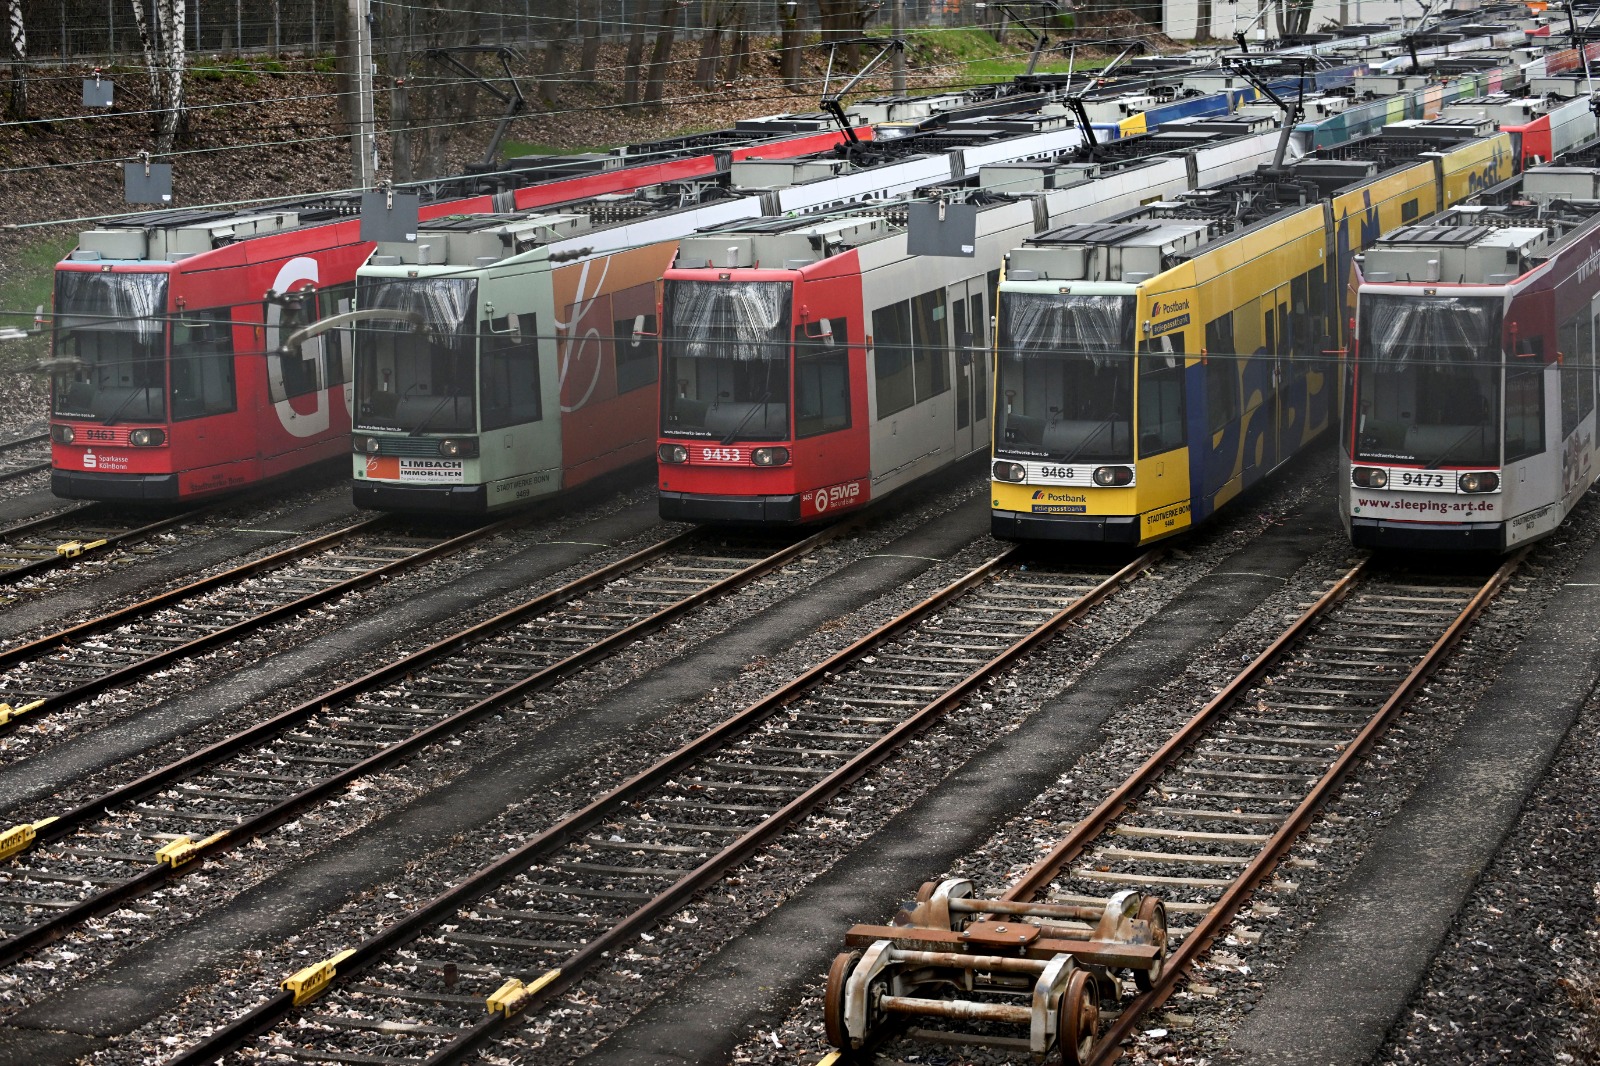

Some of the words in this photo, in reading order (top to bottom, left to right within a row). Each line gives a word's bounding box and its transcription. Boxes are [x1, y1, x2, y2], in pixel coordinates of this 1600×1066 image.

[1163, 298, 1190, 314] Postbank
[86, 429, 115, 441] 9463
[98, 455, 129, 463] Sparkasse
[702, 448, 740, 462] 9453
[98, 462, 128, 470] KölnBonn
[400, 460, 462, 469] LIMBACH
[1041, 466, 1074, 479] 9468
[1402, 472, 1444, 487] 9473
[830, 482, 860, 501] SWB
[1048, 493, 1086, 503] Postbank
[1034, 505, 1083, 513] #diepasstbank
[1358, 498, 1494, 514] www.sleeping-art.de
